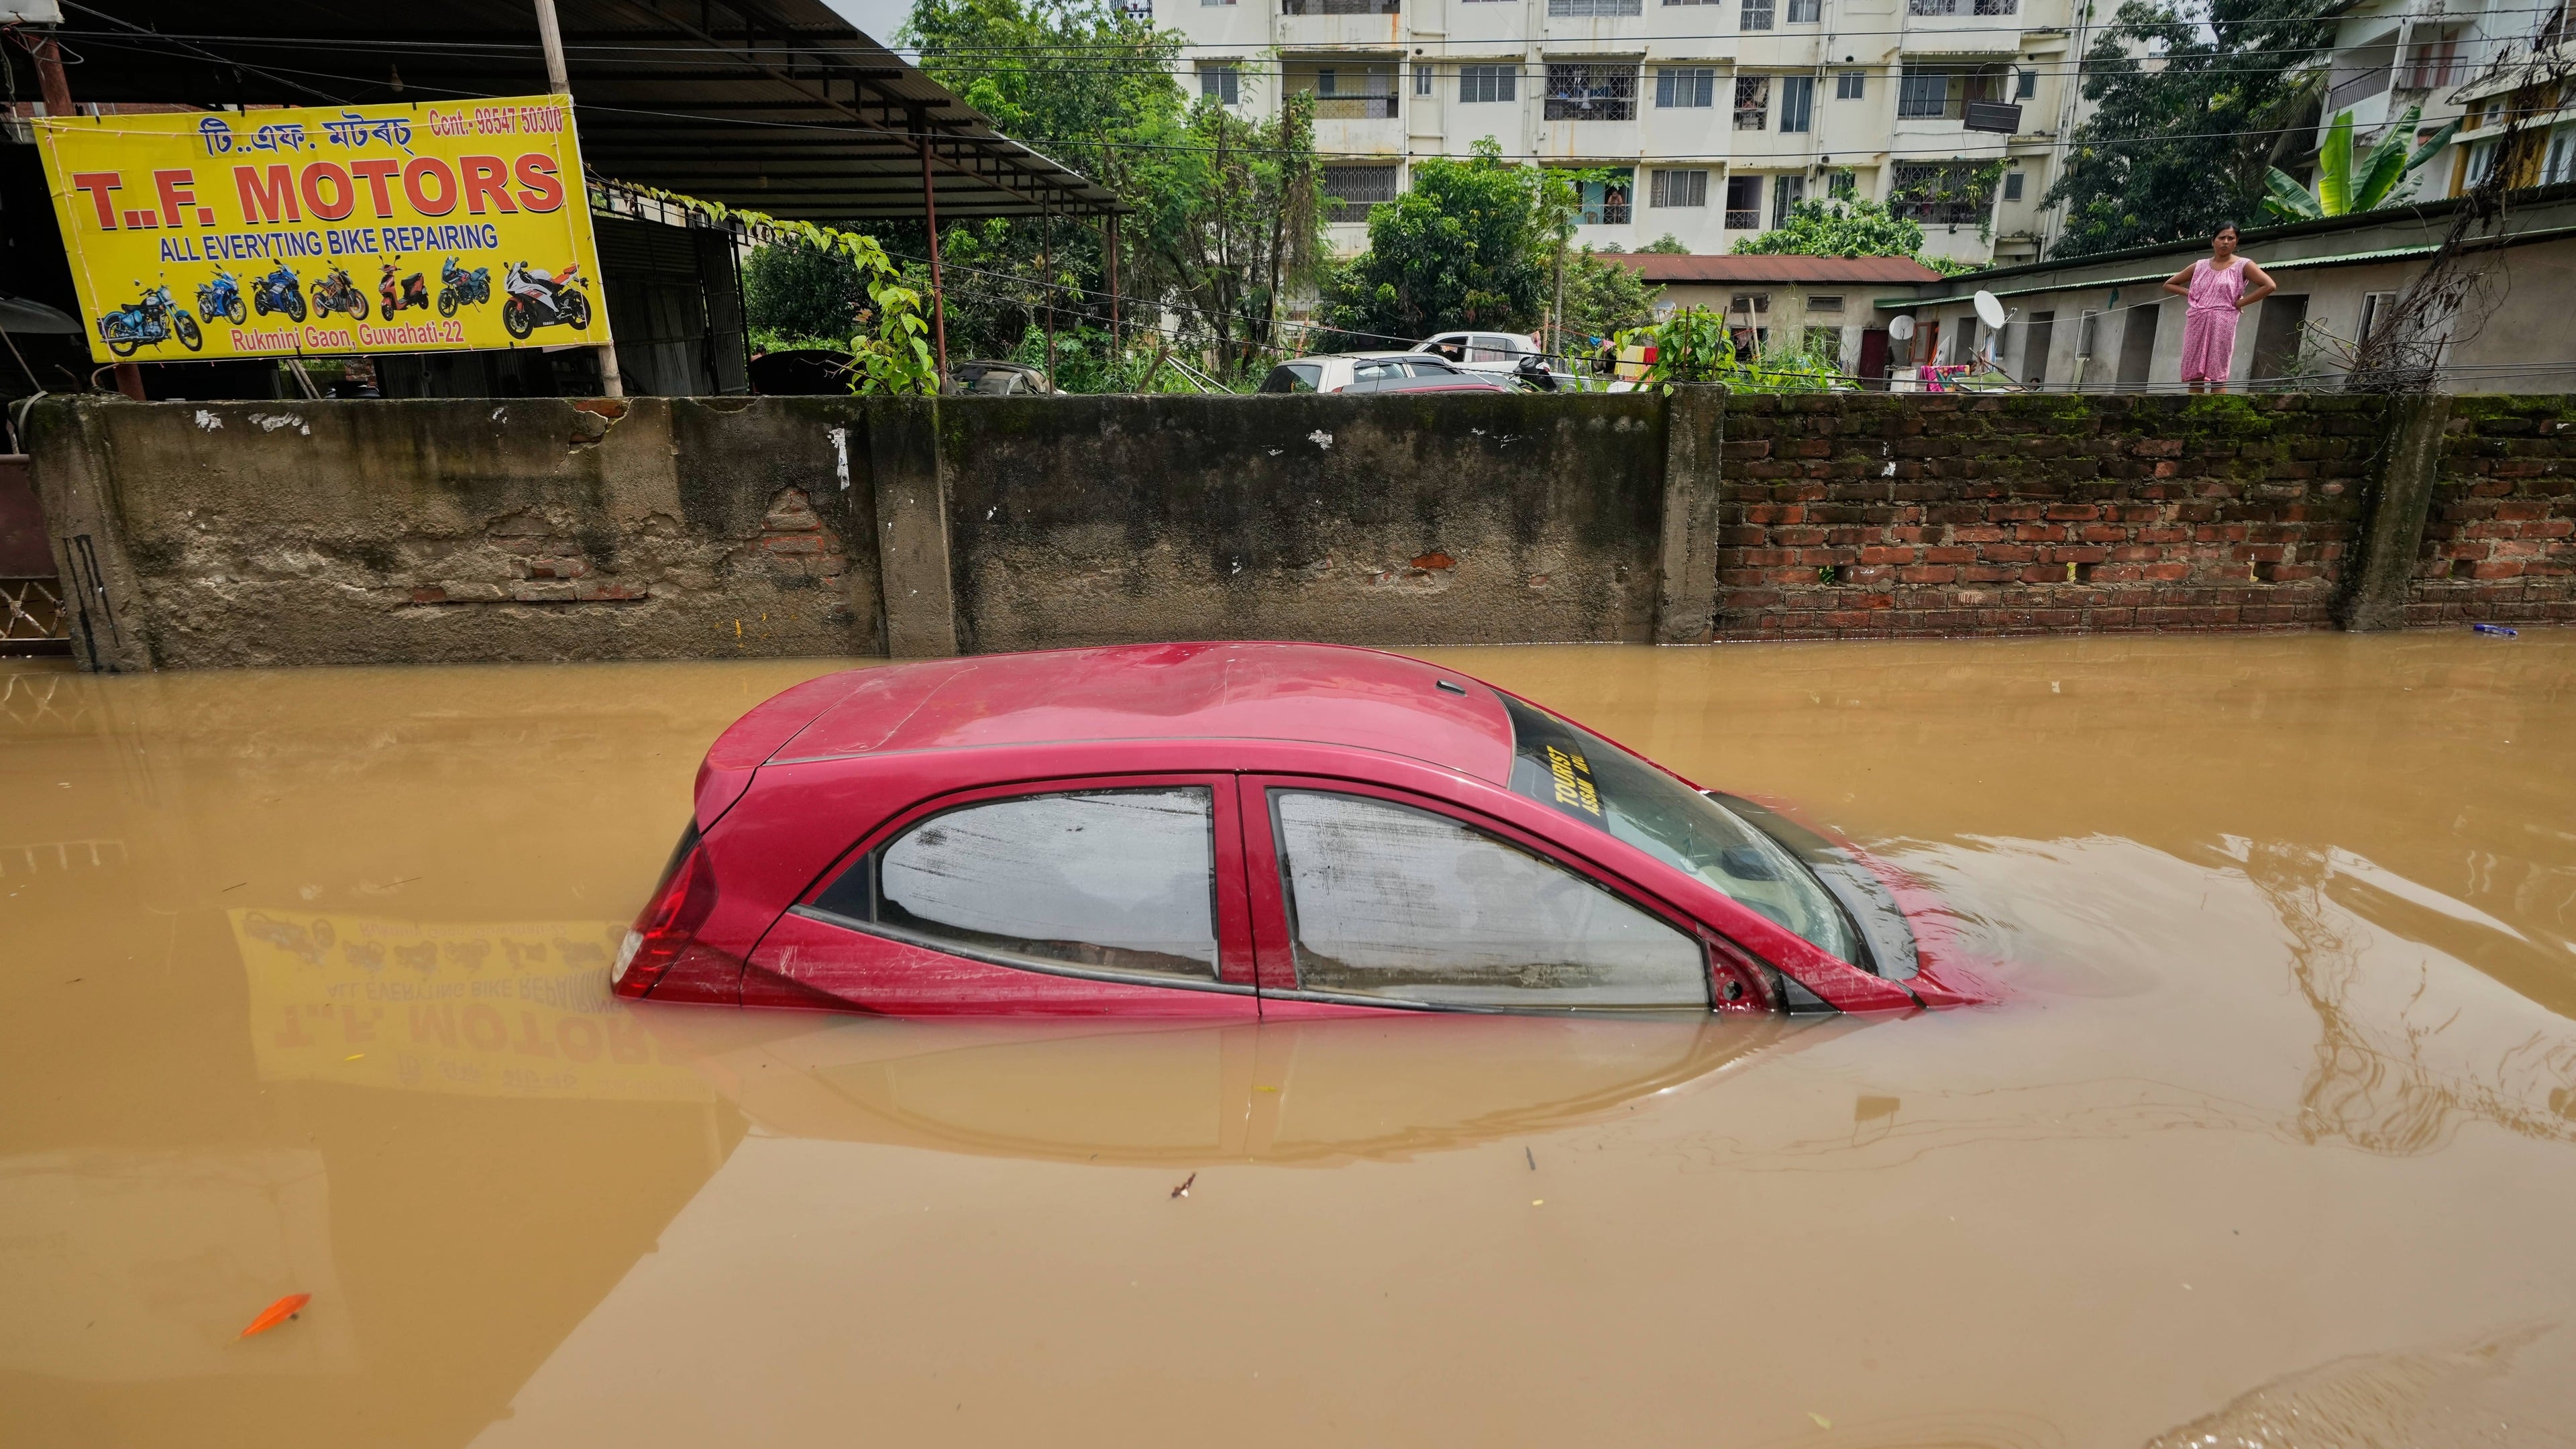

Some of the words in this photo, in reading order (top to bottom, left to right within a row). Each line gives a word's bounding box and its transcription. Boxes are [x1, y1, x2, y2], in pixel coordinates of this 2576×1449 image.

[474, 107, 516, 136] 98547
[520, 105, 564, 134] 50300
[232, 152, 564, 225] MOTORS
[160, 237, 201, 263] ALL
[203, 230, 323, 261] EVERYTING
[325, 227, 379, 256] BIKE
[382, 222, 499, 254] REPAIRING
[230, 326, 302, 352] Rukmini
[304, 325, 358, 351] Gaon,
[358, 319, 465, 347] Guwahati-22
[1546, 744, 1580, 808] TOURIST
[1576, 777, 1601, 817] ASSAM
